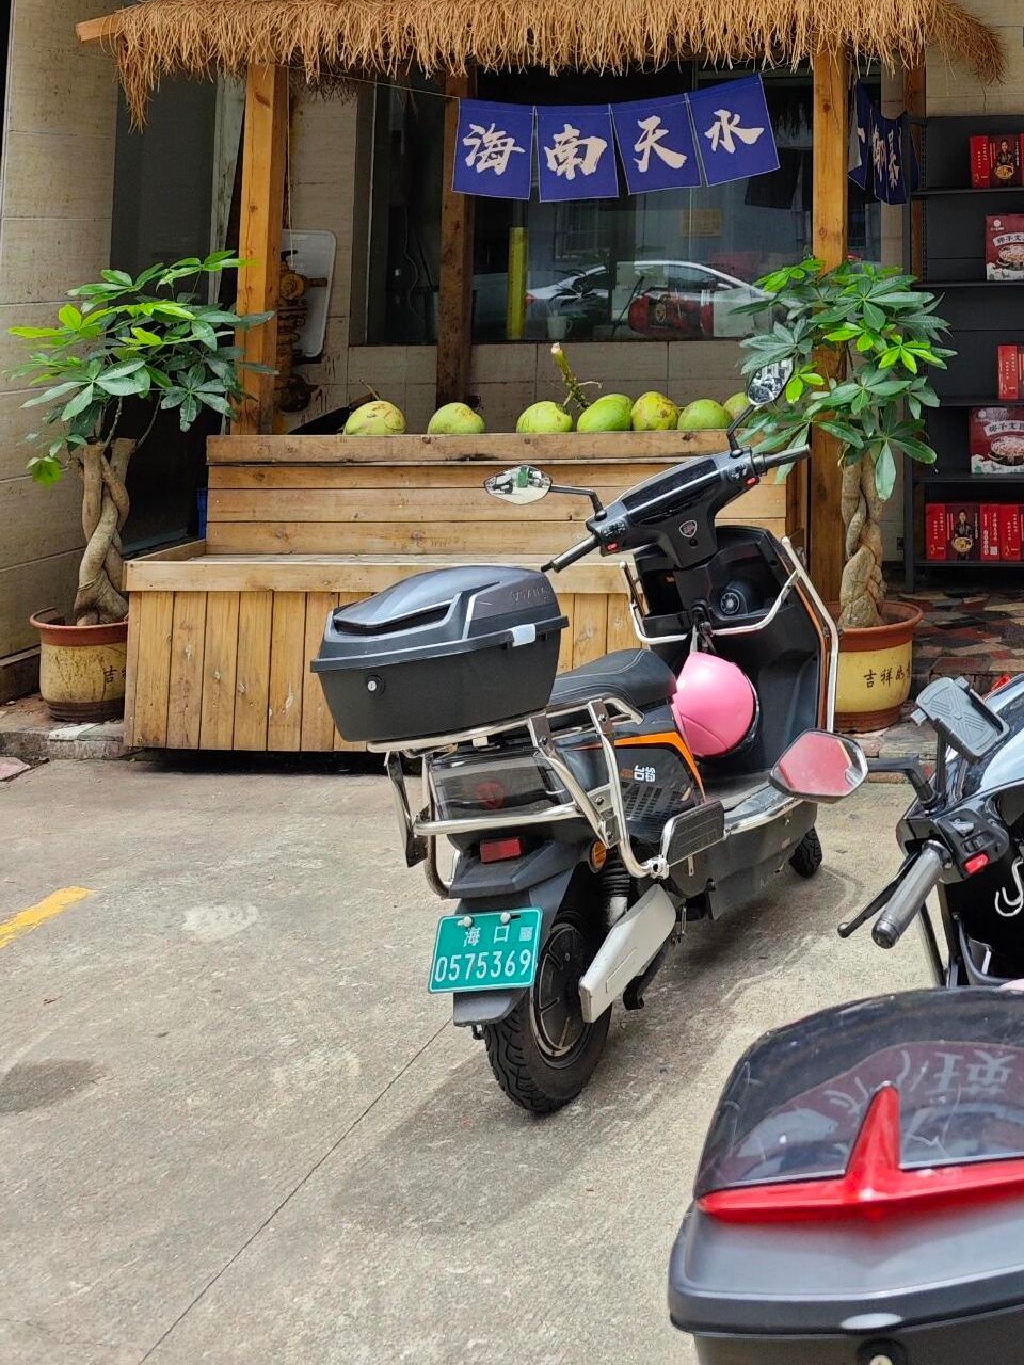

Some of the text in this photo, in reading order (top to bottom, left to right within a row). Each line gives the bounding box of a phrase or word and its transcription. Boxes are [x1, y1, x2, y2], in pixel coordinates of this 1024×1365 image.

[462, 109, 766, 180] 海南天水
[634, 764, 655, 782] 台铃
[434, 948, 532, 982] 0575369
